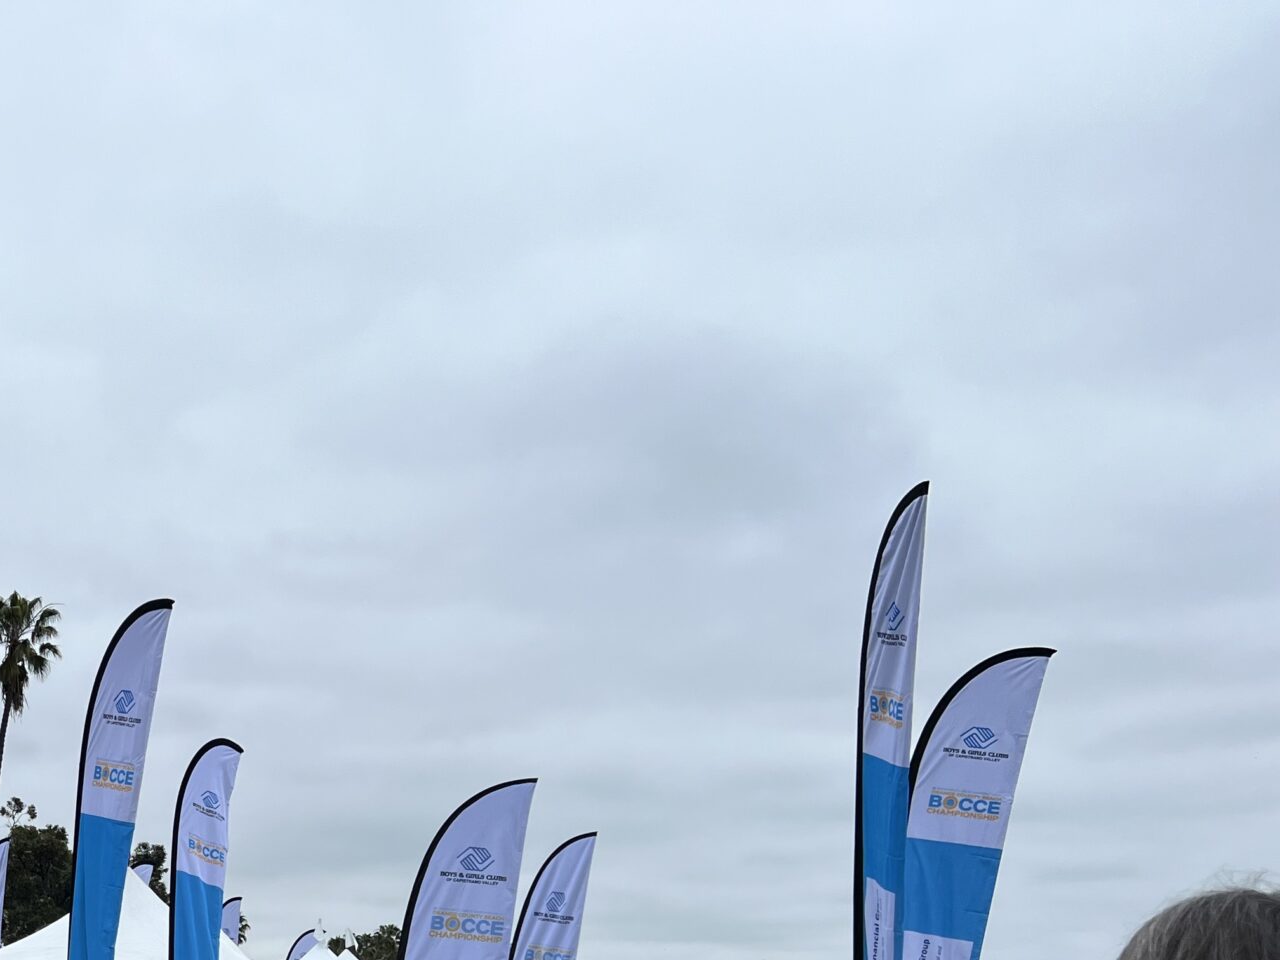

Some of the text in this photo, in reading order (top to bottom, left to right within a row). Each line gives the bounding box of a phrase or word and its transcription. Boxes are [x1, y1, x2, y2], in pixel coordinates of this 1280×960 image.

[928, 794, 1002, 815] BOCCE
[440, 870, 457, 878] BOYS
[430, 915, 504, 936] BOCCE
[428, 930, 503, 943] CHAMPIONSHIP
